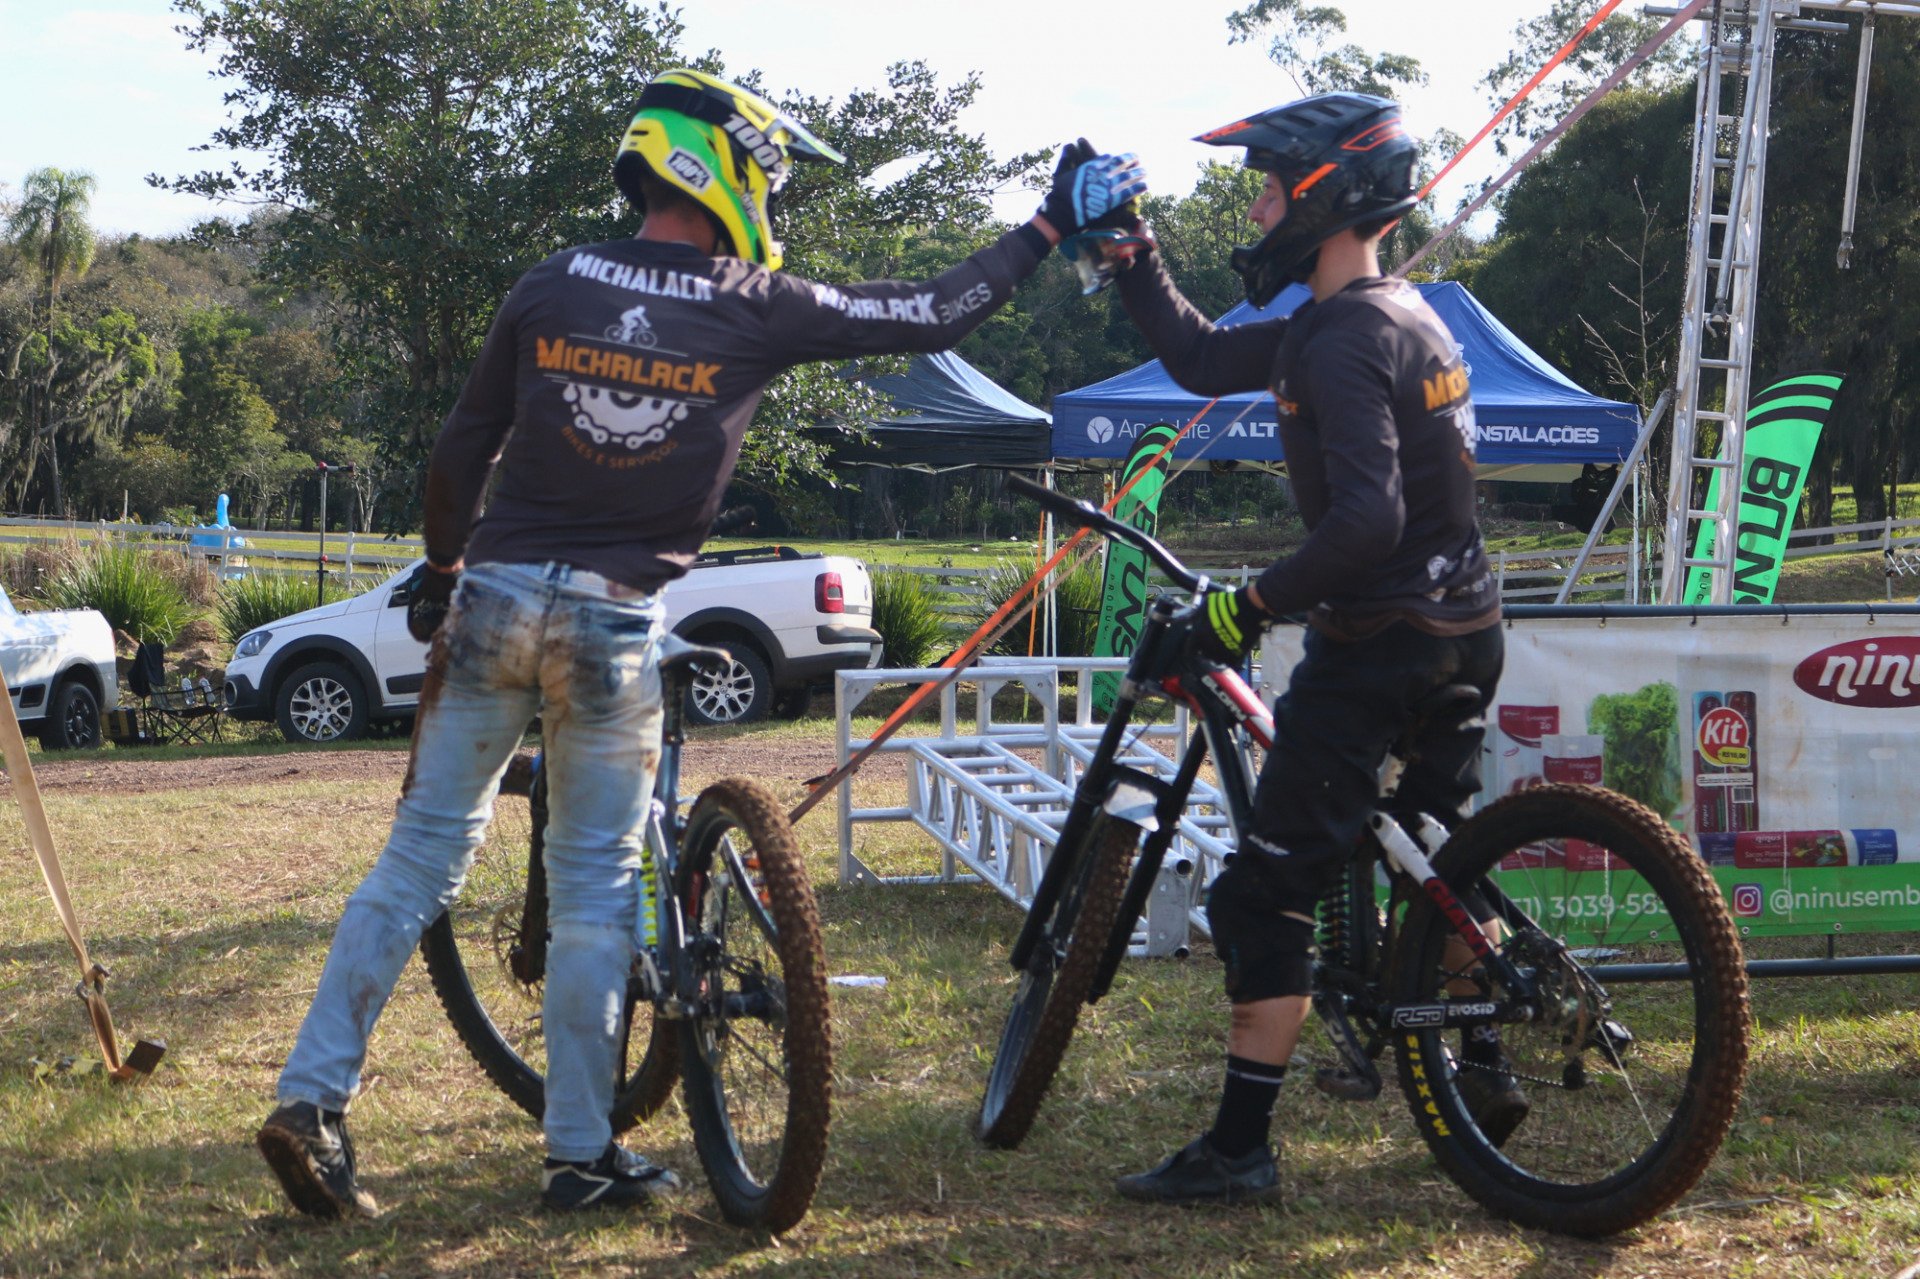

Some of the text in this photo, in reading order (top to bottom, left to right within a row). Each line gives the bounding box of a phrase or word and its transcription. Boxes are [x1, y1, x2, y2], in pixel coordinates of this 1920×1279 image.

[667, 153, 711, 190] 100%
[567, 252, 713, 301] MICHALACK
[536, 336, 722, 396] MICHALACK
[1476, 424, 1600, 447] NSTALAÇÕES
[1703, 717, 1743, 745] Kit
[1769, 884, 1920, 915] @ninusemb
[1406, 1034, 1451, 1137] MAXXIS
